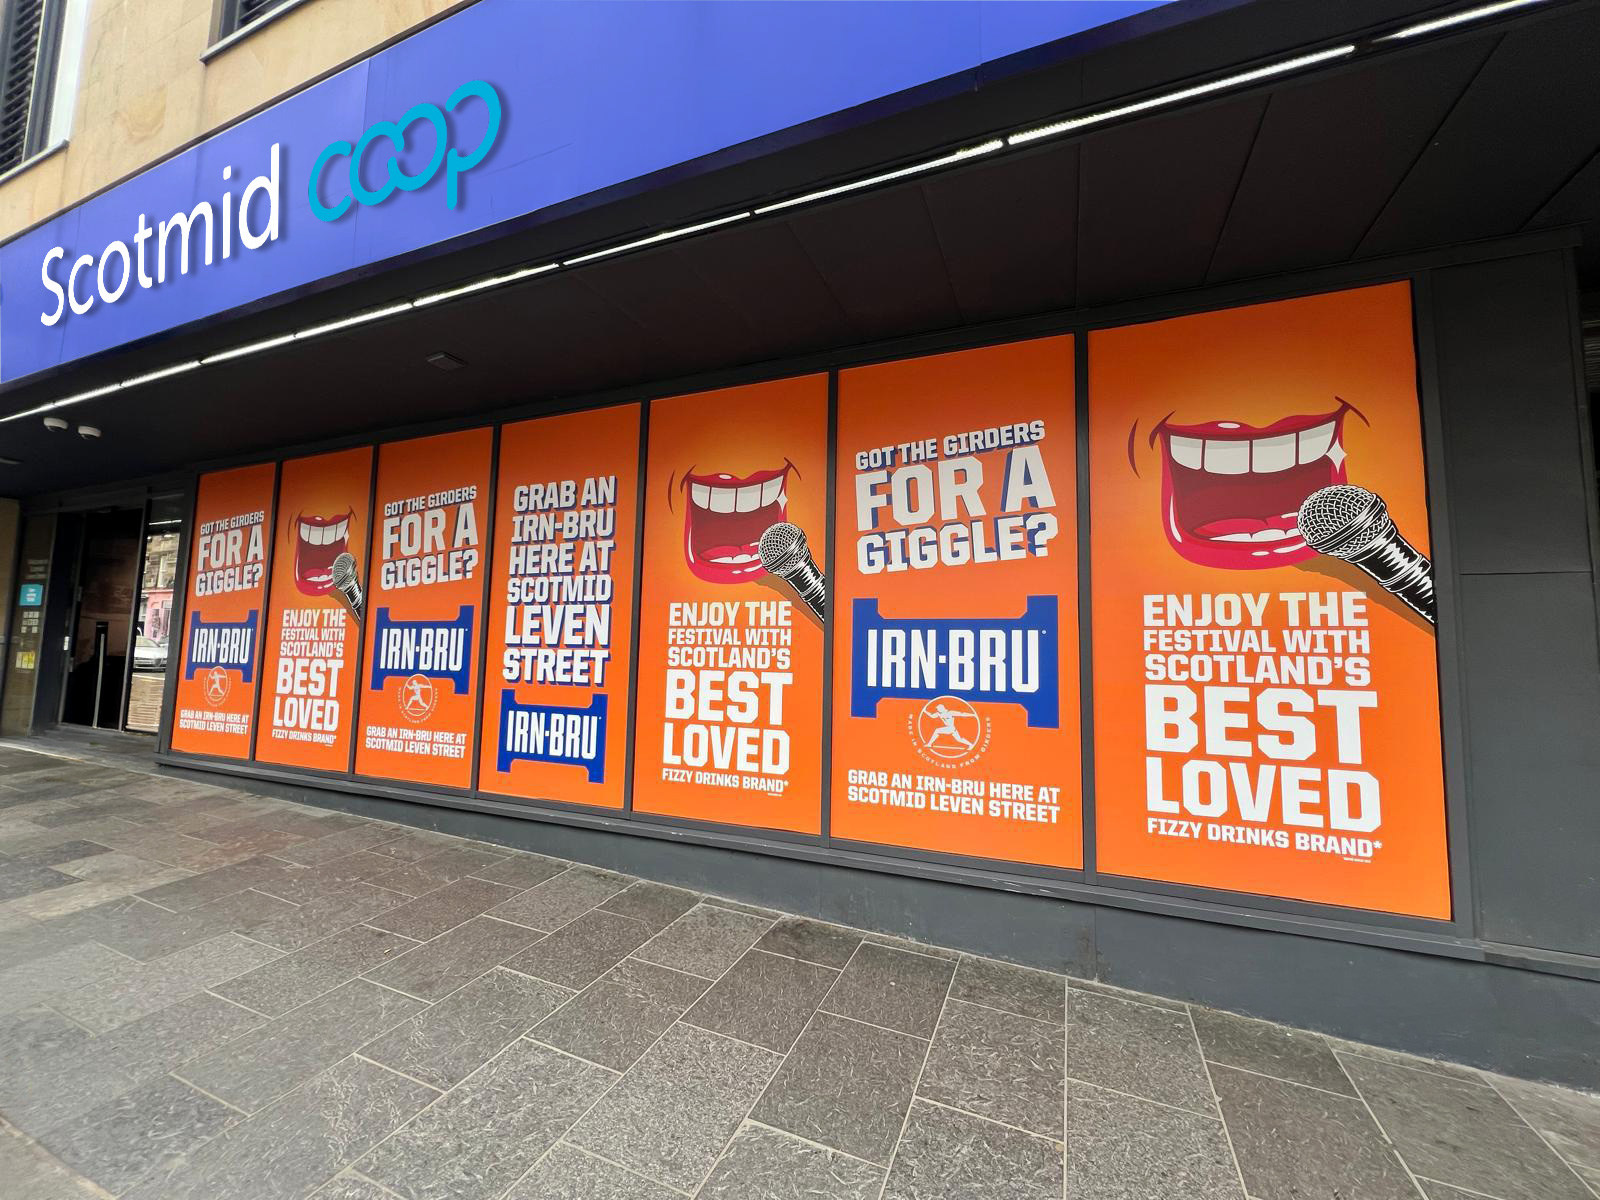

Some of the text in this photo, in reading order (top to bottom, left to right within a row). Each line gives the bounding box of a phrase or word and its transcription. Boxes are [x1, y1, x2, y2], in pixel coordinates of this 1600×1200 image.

[40, 79, 502, 327] Scotmid coop
[855, 420, 1045, 471] GOT THE GIRDERS
[384, 485, 477, 516] GOT THE GIRDERS
[513, 475, 616, 512] GRAB AN
[855, 444, 1057, 532] FOR A
[200, 510, 265, 535] GOT THE GIRDERS
[382, 502, 479, 560] FOR A
[511, 510, 614, 543] IRN-BRU
[197, 525, 265, 571] FOR A
[509, 540, 615, 576] HERE AT
[856, 513, 1059, 575] GIGGLE?
[195, 564, 263, 597] GIGGLE?
[380, 549, 479, 591] GIGGLE?
[506, 574, 612, 603] SCOTMID
[282, 609, 347, 627] ENJOY THE
[504, 605, 609, 645] LEVEN
[668, 601, 792, 627] ENJOY THE
[1143, 591, 1368, 627] ENJOY THE
[280, 641, 344, 658] SCOTLAND'S
[281, 627, 345, 641] FESTIVAL WITH
[668, 628, 792, 646] FESTIVAL WITH
[1143, 629, 1370, 654] FESTIVAL WITH
[502, 649, 609, 684] STREET
[668, 646, 790, 670] SCOTLAND'S
[1145, 653, 1371, 686] SCOTLAND'S
[276, 658, 344, 698] BEST
[273, 696, 340, 732] LOVED
[665, 669, 793, 726] BEST
[179, 718, 249, 735] SCOTMID LEVEN STREET
[180, 710, 249, 724] GRAB AN IRN-BRU HERE AT
[1145, 684, 1378, 765] BEST
[271, 730, 288, 739] FIZZY
[289, 731, 312, 742] DRINKS
[365, 738, 466, 759] SCOTMID LEVEN STREET
[366, 726, 467, 745] GRAB AN IRN-BRU HERE AT
[662, 722, 791, 775] LOVED
[662, 768, 692, 783] FIZZY
[695, 771, 740, 787] DRINKS
[848, 769, 1060, 804] GRAB AN IRN-BRU HERE AT
[1145, 756, 1382, 833] LOVED
[848, 786, 1060, 823] SCOTMID LEVEN STREET
[1147, 818, 1202, 840] FIZZY
[1207, 823, 1289, 848] DRINKS
